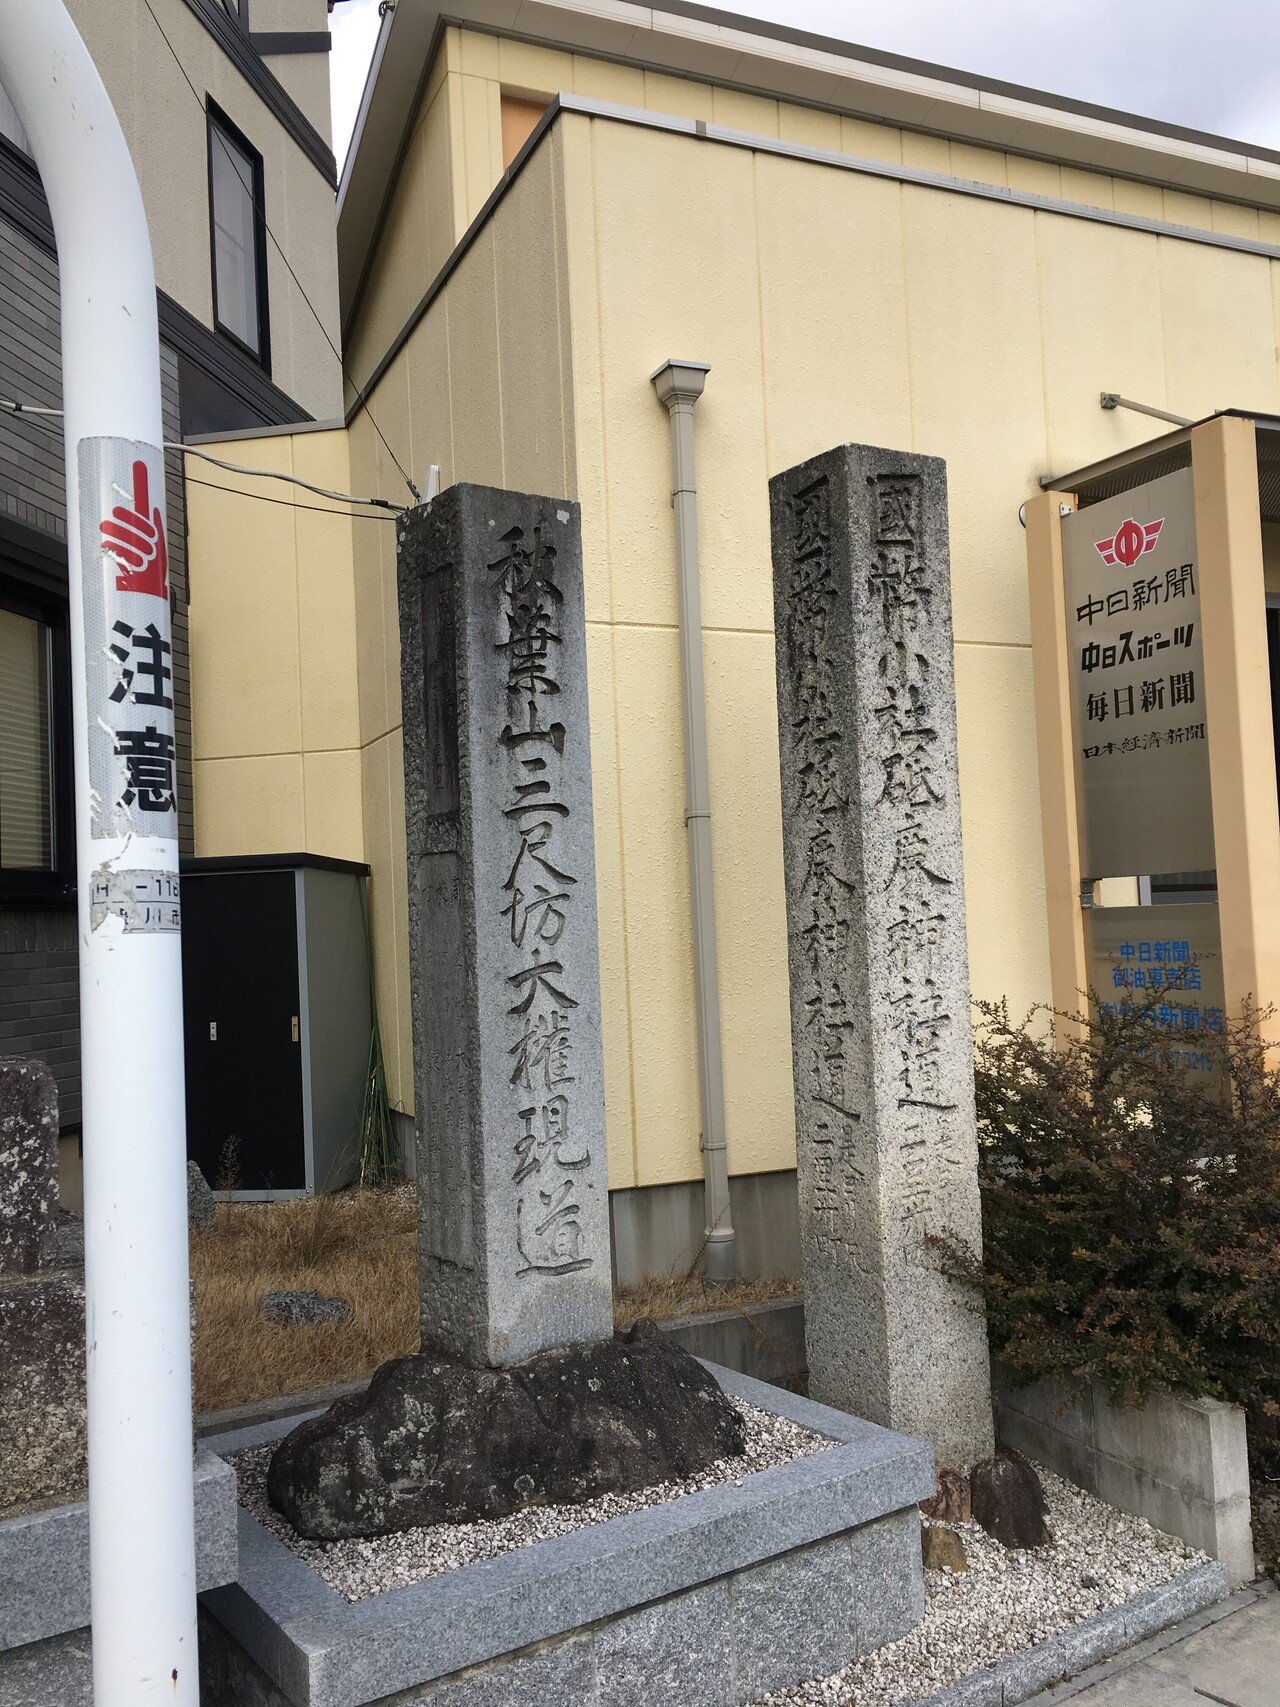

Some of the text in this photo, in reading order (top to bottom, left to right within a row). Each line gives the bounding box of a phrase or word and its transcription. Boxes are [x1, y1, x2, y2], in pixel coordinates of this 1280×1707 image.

[1076, 563, 1196, 626] 中日新聞
[1081, 623, 1195, 673] 中日スポーツ
[108, 619, 176, 812] 注意
[1086, 670, 1195, 723] 毎日新聞
[1120, 941, 1190, 963] 中日新聞
